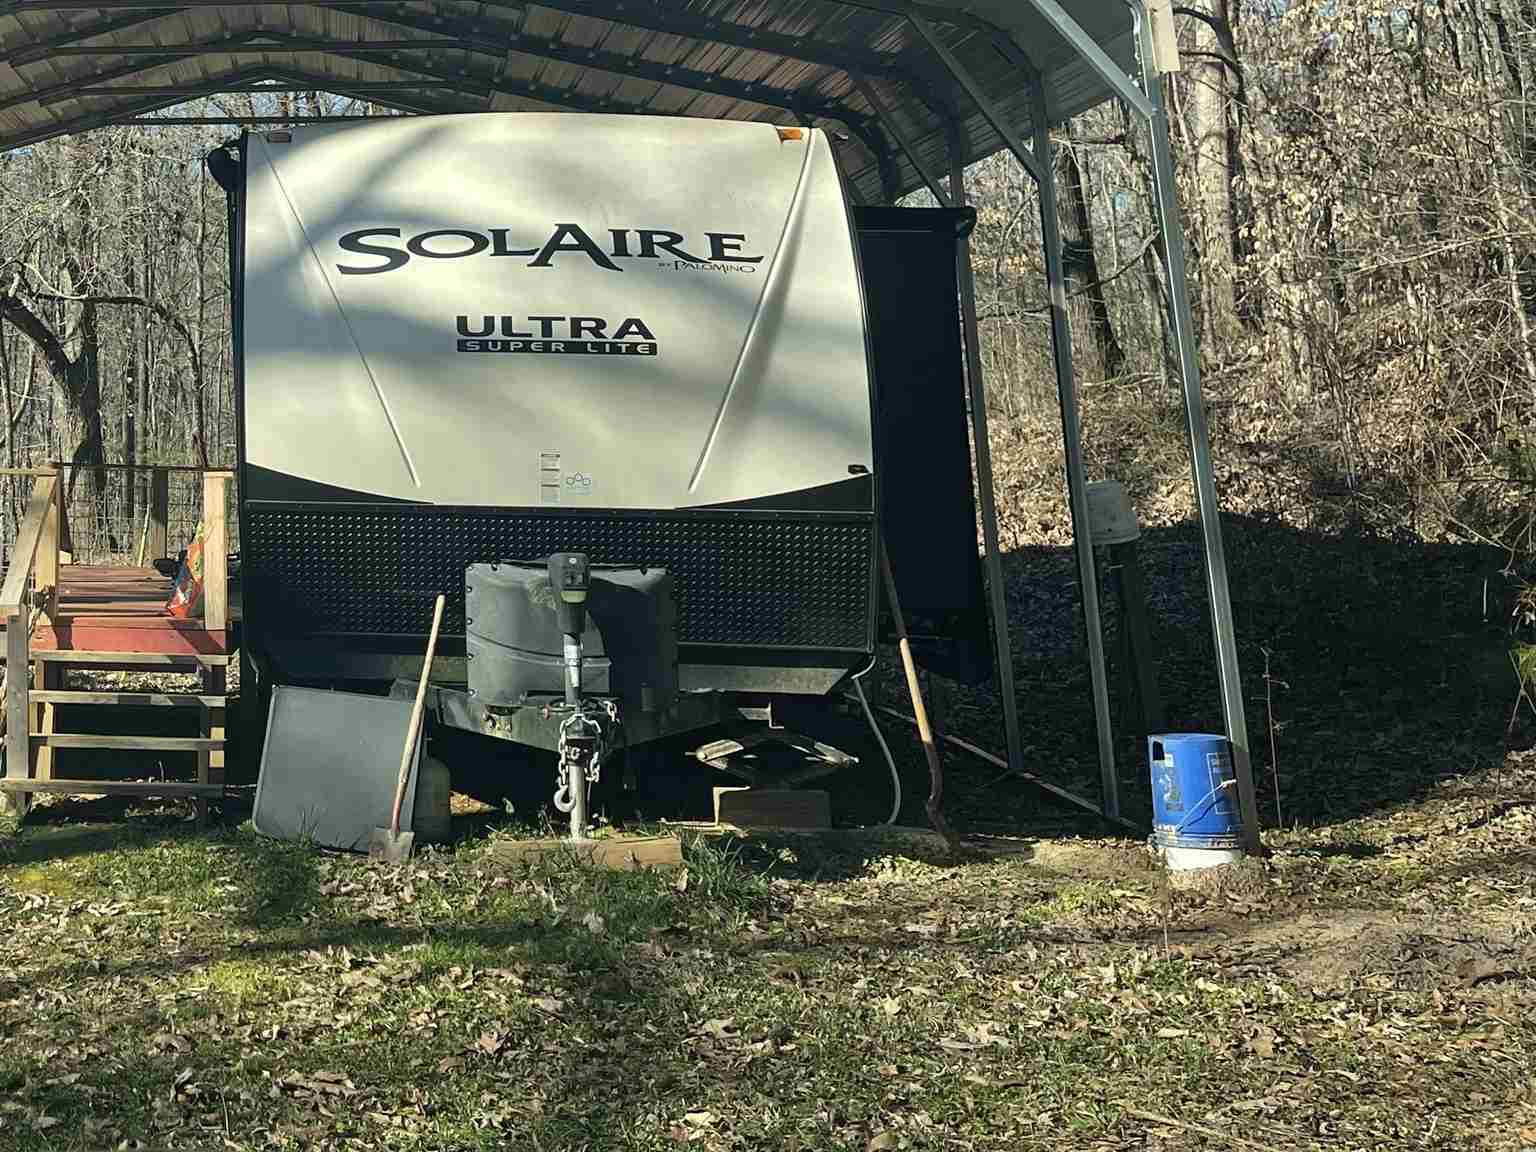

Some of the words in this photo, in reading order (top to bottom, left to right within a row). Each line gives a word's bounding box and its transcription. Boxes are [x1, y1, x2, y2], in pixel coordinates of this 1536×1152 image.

[336, 223, 764, 275] SOLAIRE
[673, 260, 756, 273] PALOMINO
[456, 315, 657, 339] ULTRA
[466, 341, 565, 353] SUPER
[586, 342, 651, 354] LITE
